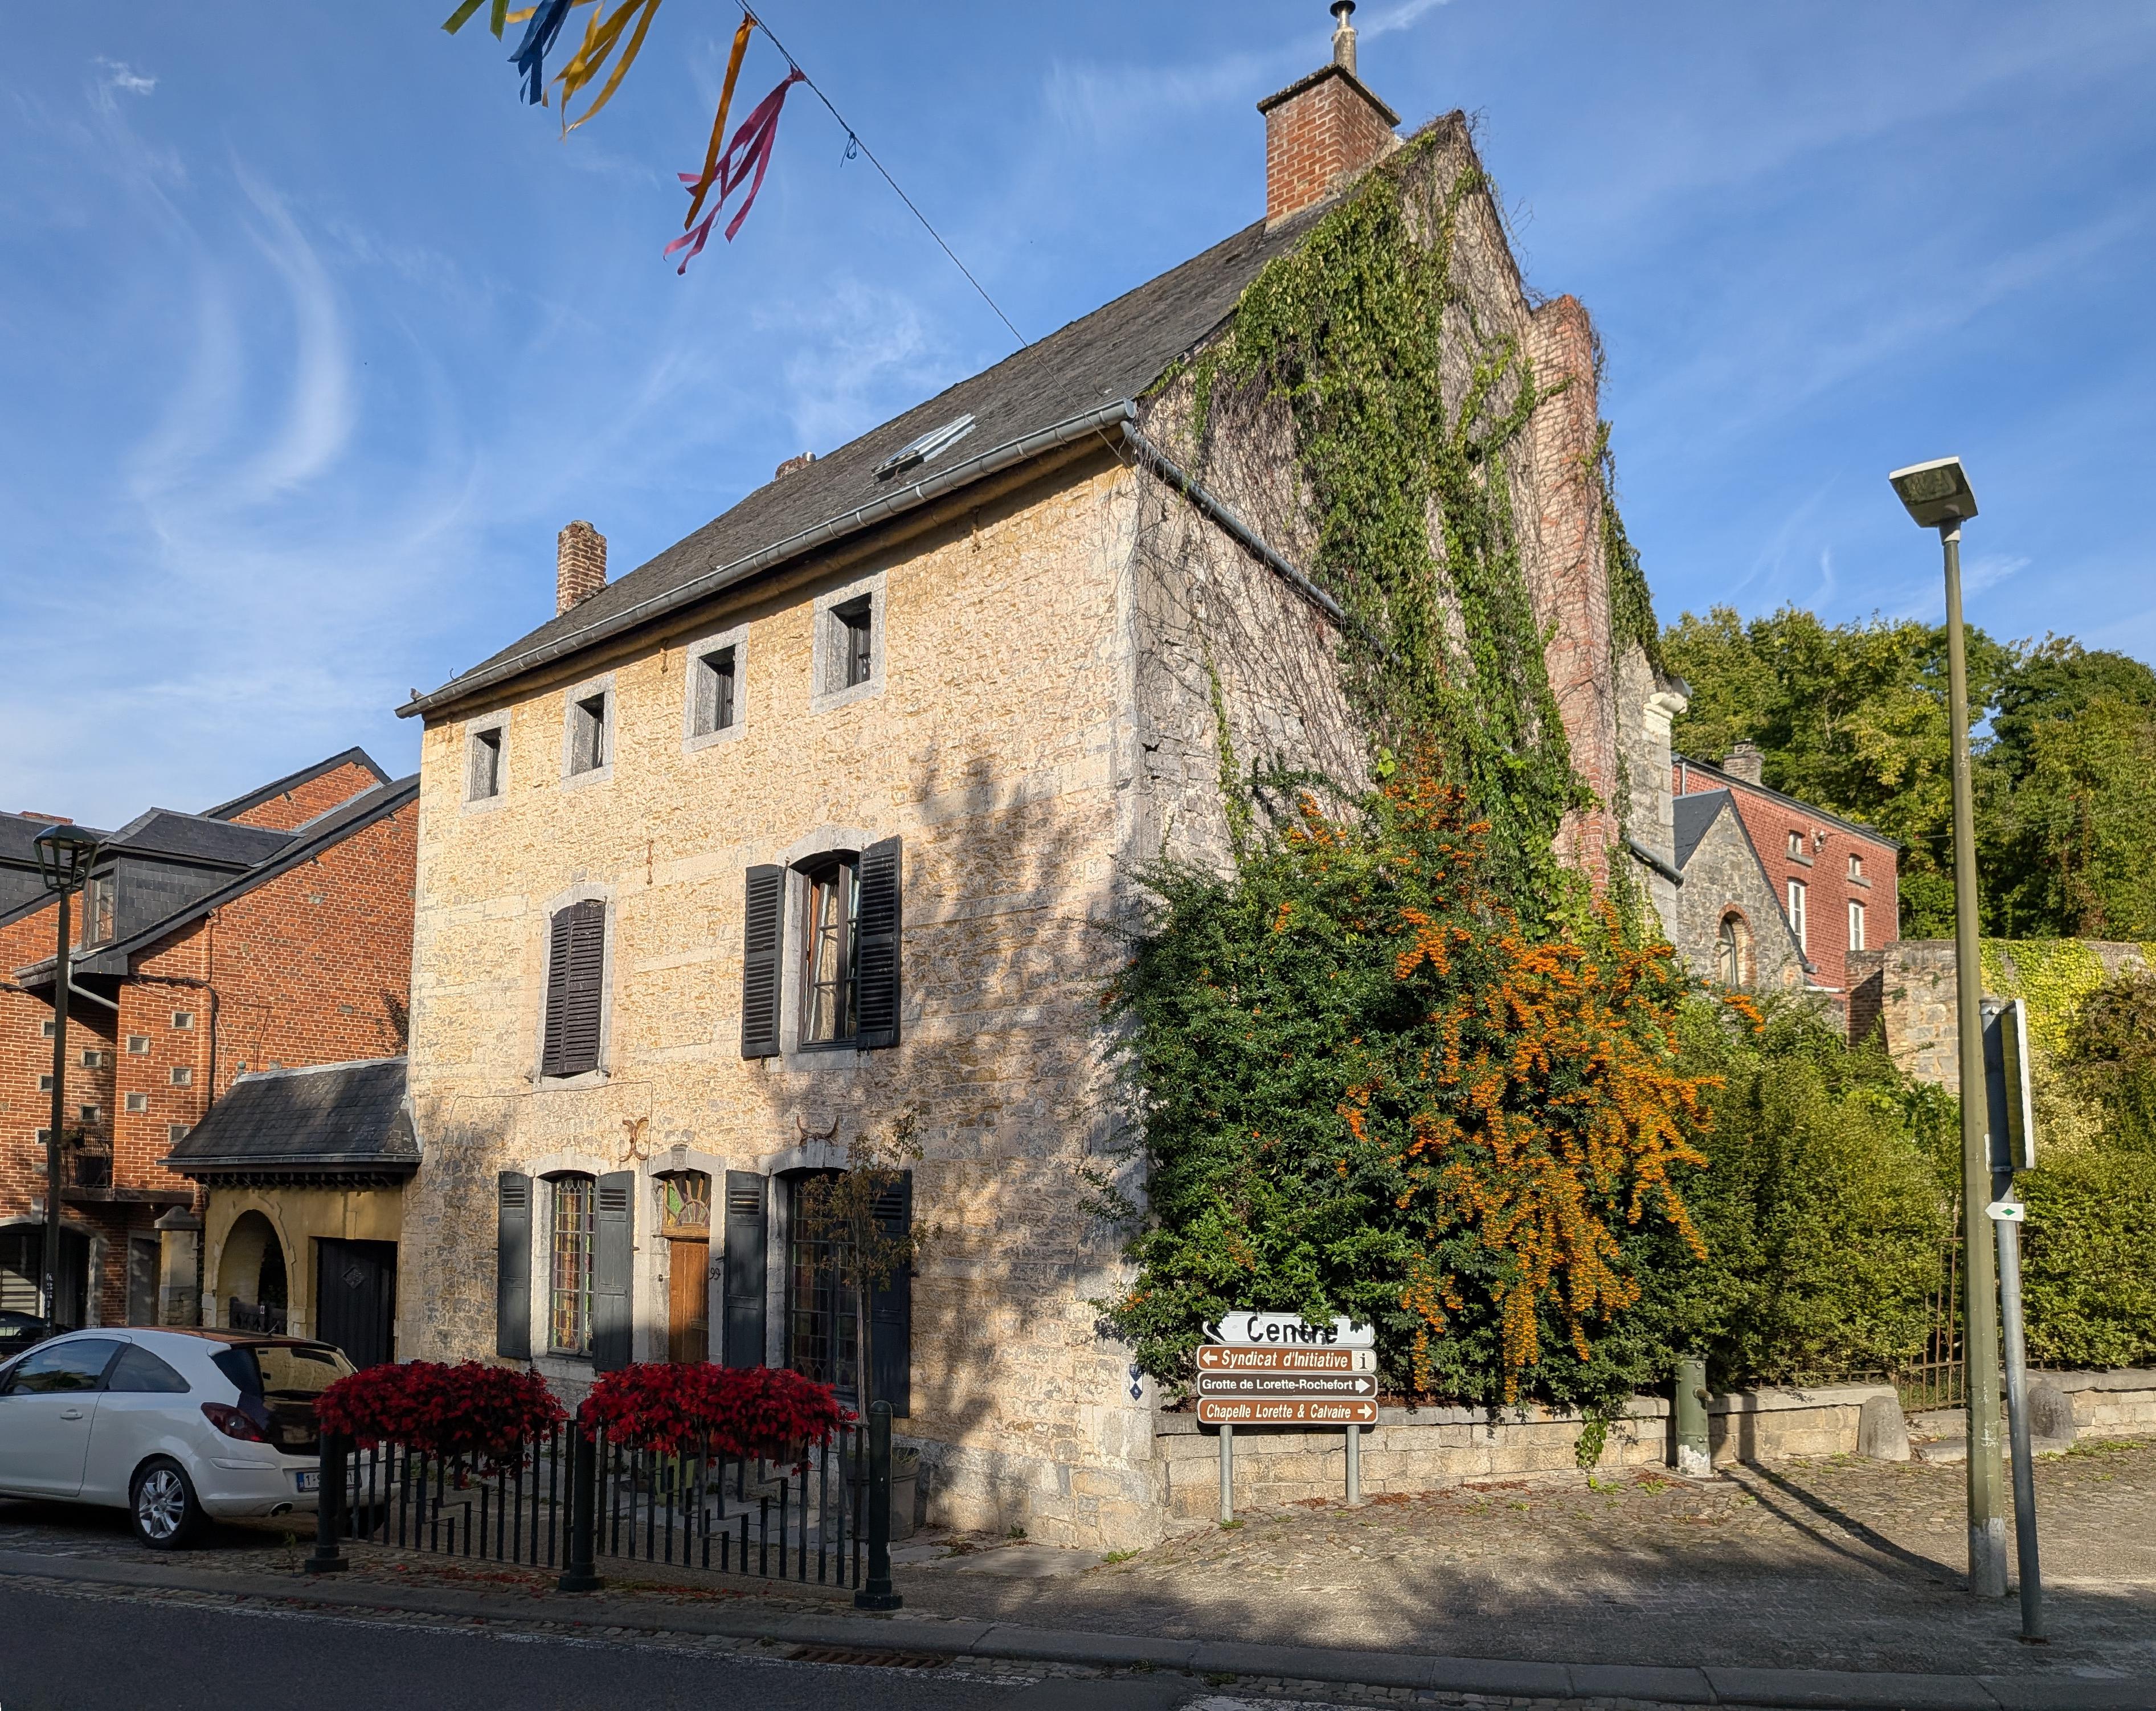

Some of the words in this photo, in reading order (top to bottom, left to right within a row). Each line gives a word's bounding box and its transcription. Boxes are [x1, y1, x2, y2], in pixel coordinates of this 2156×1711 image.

[709, 1267, 721, 1280] 99
[1247, 1316, 1339, 1343] Centre
[1221, 1349, 1277, 1368] Syndicat
[1283, 1351, 1348, 1368] d'Initiative
[1202, 1379, 1237, 1389] Grotte
[1239, 1379, 1254, 1389] de
[1256, 1379, 1353, 1390] Lorette-Rochefort
[1206, 1403, 1251, 1421] Chapelle
[1255, 1403, 1292, 1418] Lorette
[1297, 1403, 1305, 1418] &
[1310, 1403, 1351, 1418] Calvaire
